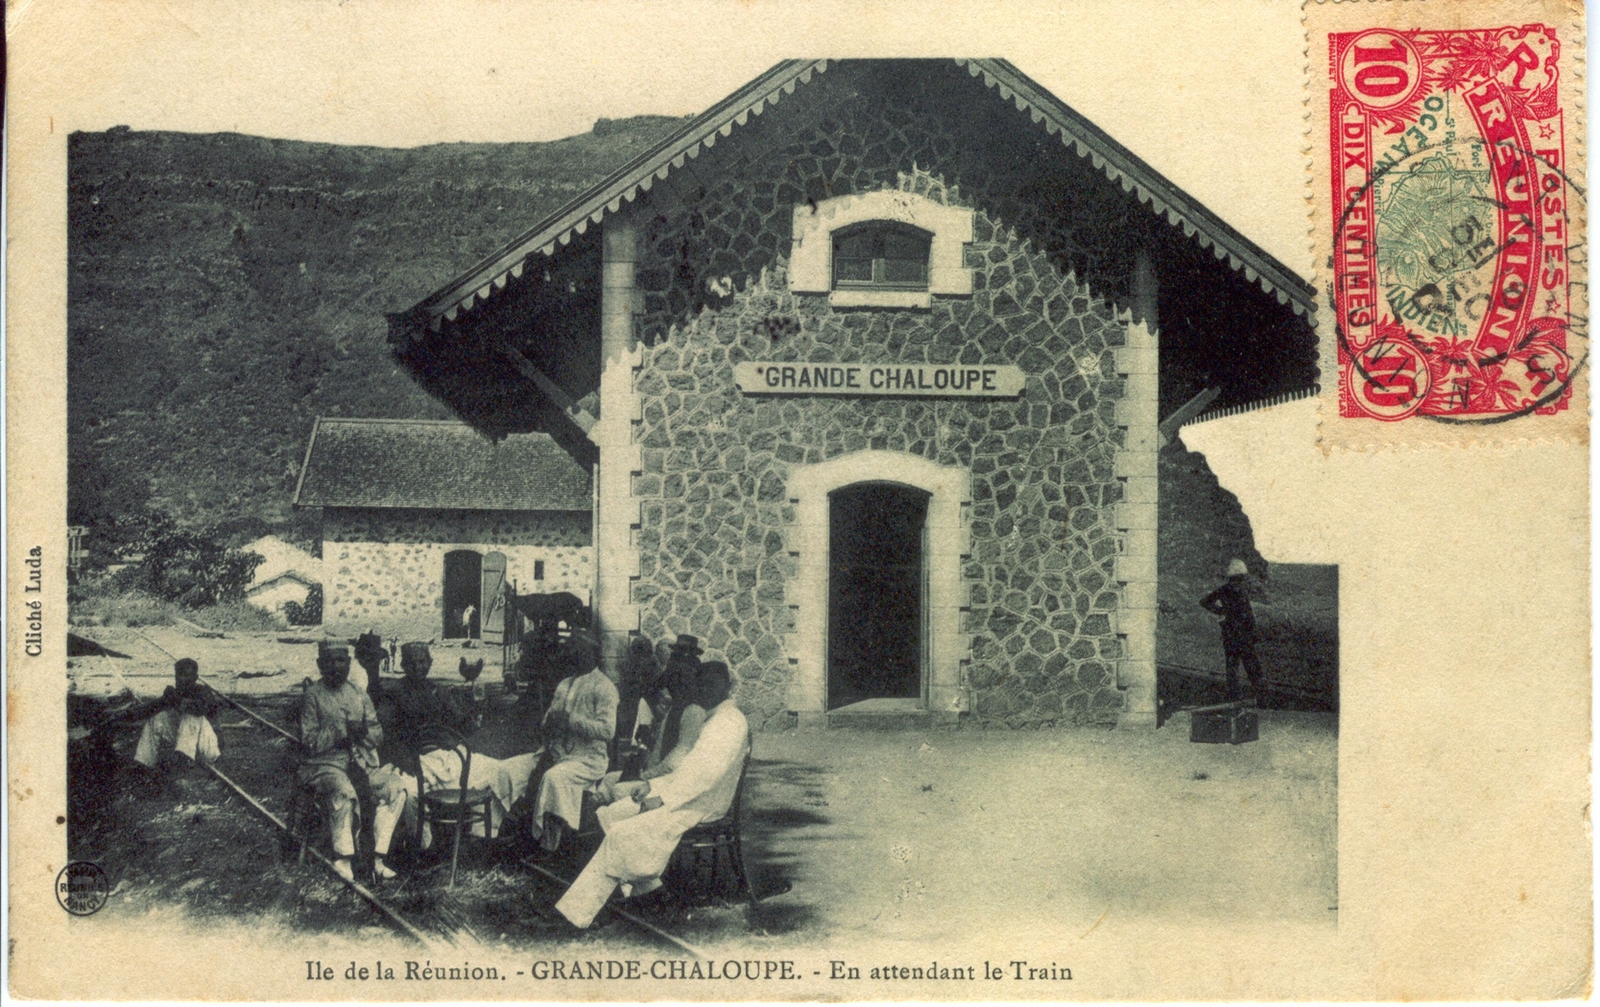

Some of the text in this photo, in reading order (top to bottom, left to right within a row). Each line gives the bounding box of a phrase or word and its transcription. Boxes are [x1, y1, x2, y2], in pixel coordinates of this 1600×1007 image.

[1328, 33, 1338, 83] CHAUVET
[1353, 38, 1409, 98] 10
[1500, 41, 1540, 91] R
[1470, 143, 1483, 168] Port
[1344, 122, 1371, 326] DIX CENTIMES
[1536, 149, 1564, 291] POSTES
[1386, 285, 1460, 337] INDIEN
[765, 365, 997, 391] GRANDE CHALOUPE
[1363, 345, 1418, 407] 10
